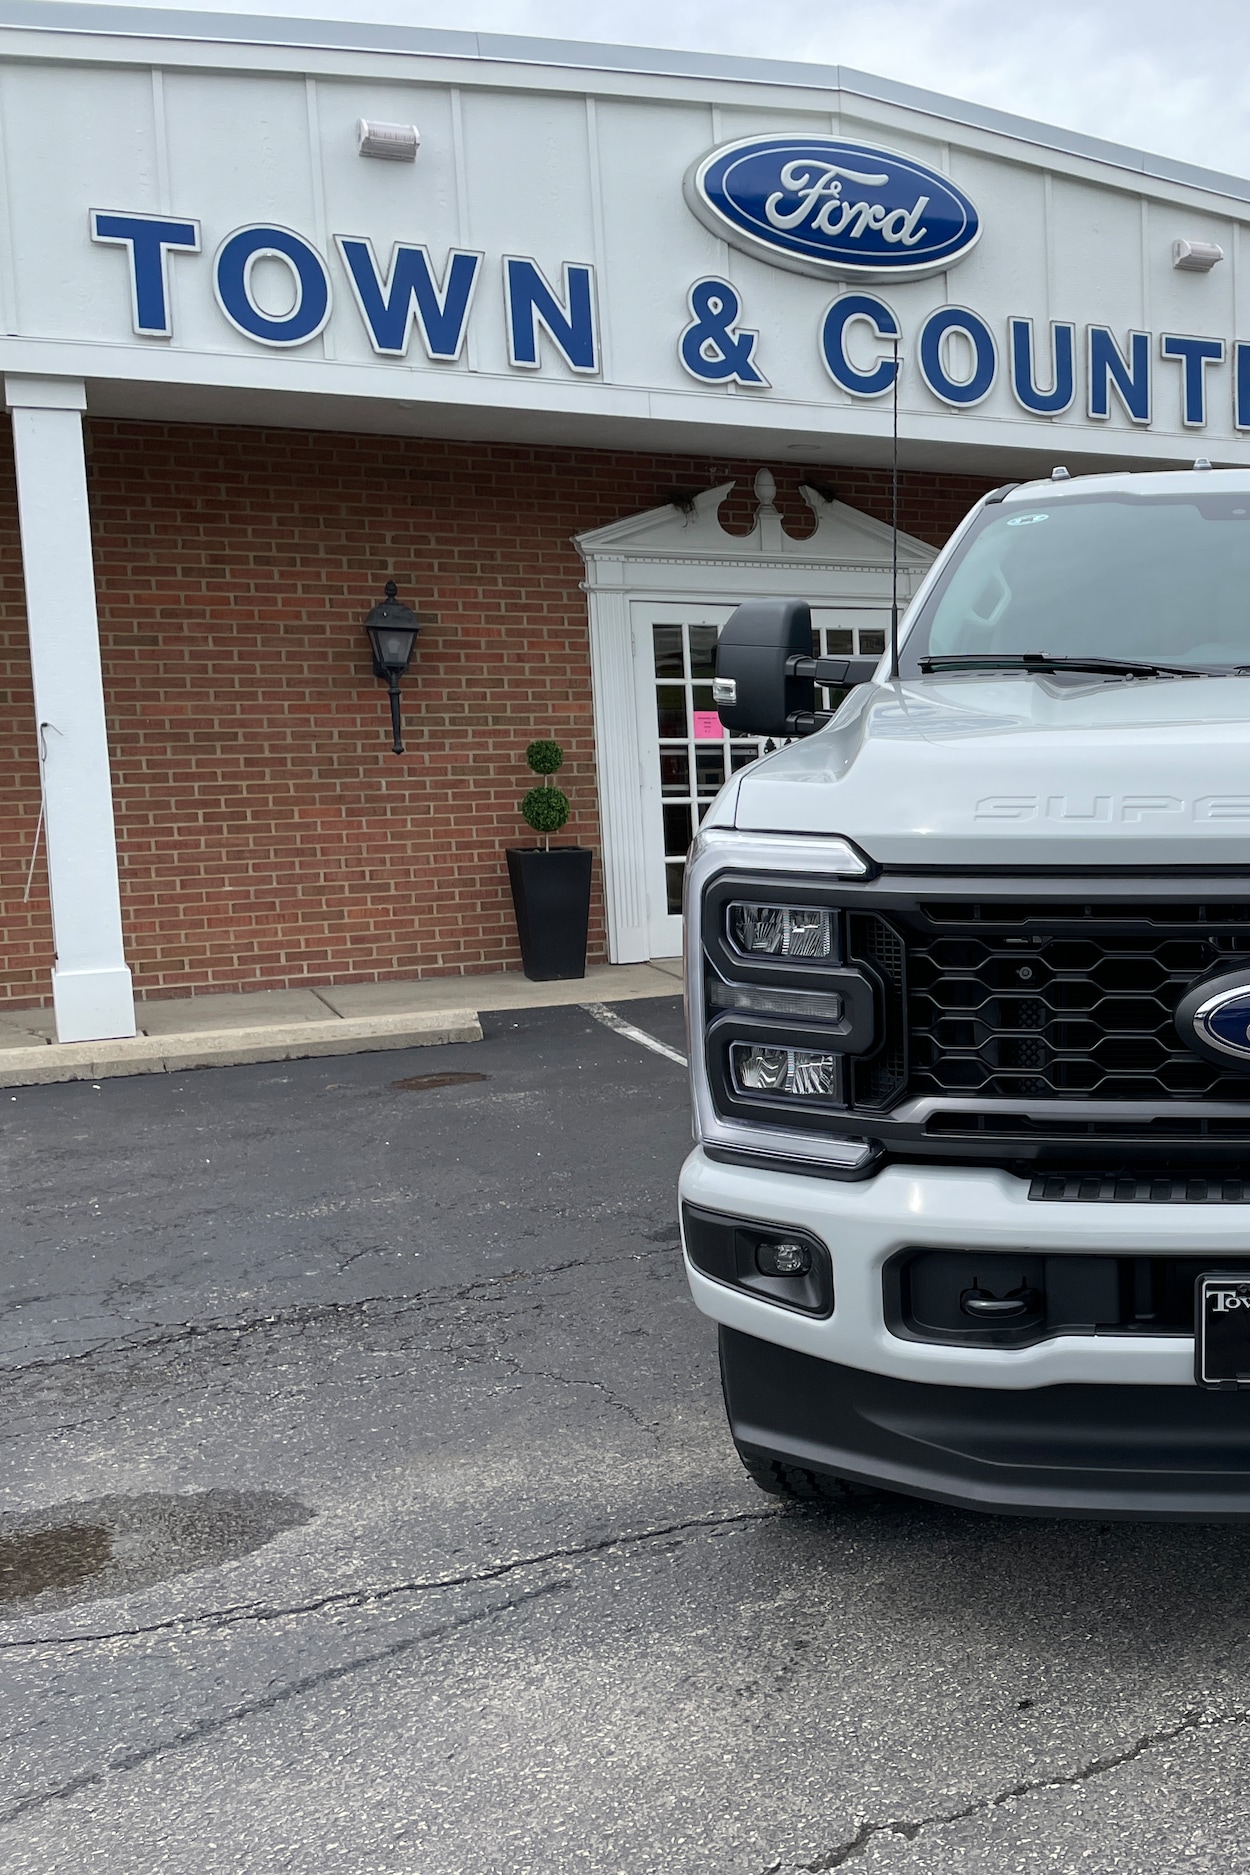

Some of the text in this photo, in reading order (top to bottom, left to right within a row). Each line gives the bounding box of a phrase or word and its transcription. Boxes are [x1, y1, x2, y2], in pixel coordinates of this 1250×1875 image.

[764, 158, 930, 247] Ford
[88, 207, 602, 376] TOWN
[677, 274, 773, 389] &
